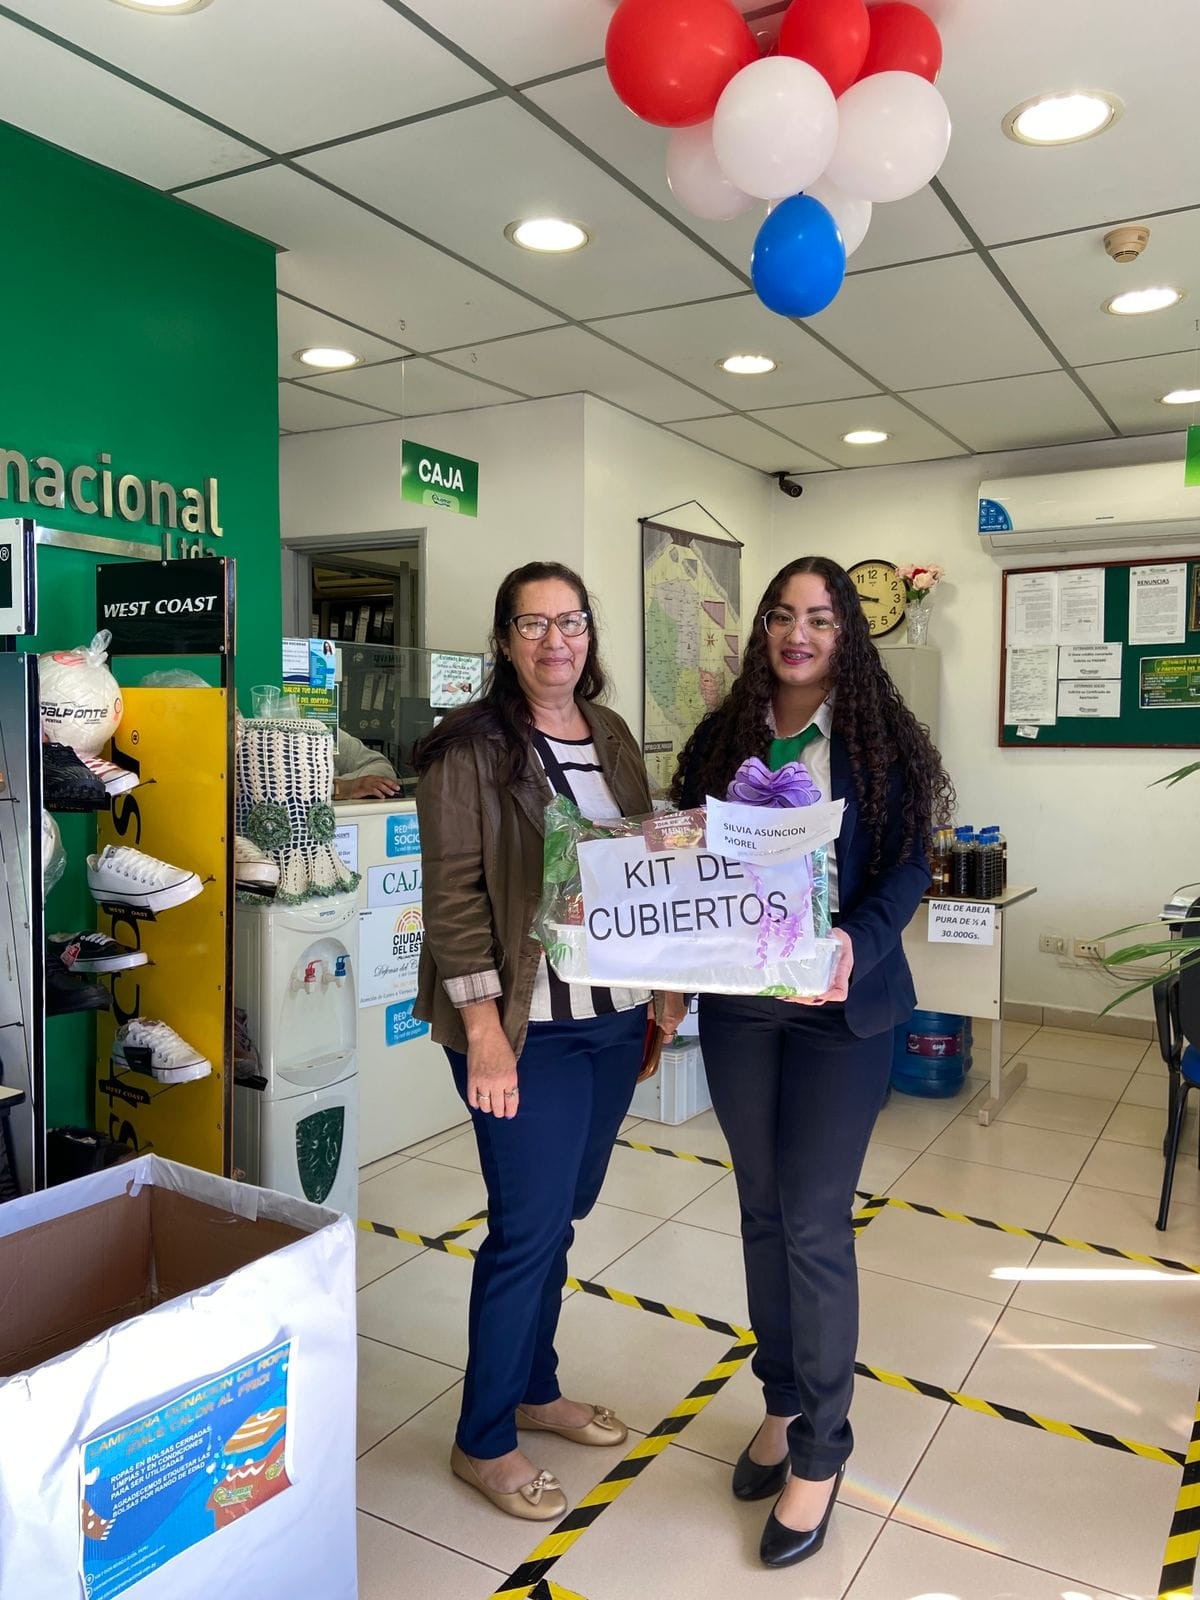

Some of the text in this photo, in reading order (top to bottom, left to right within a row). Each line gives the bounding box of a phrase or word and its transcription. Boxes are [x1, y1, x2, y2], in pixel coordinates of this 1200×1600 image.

[418, 458, 464, 492] CAJA
[857, 574, 865, 584] 11
[868, 569, 878, 580] 12
[884, 572, 888, 582] 1
[891, 581, 898, 591] 2
[1137, 578, 1170, 587] RENUNCIAS
[894, 593, 901, 604] 3
[104, 595, 217, 618] WEST COAST
[889, 606, 897, 616] 4
[881, 615, 889, 626] 5
[394, 824, 408, 834] RED
[723, 822, 806, 837] SILVIA ASUNCION
[724, 835, 757, 850] MOREL
[624, 854, 744, 889] KIT DE
[932, 903, 990, 914] MIEL DE ABEJA
[588, 890, 788, 941] CUBIERTOS
[935, 915, 957, 924] PURA
[959, 917, 970, 925] DE
[980, 919, 987, 927] A
[942, 930, 980, 940] 30.000Gs.
[392, 944, 407, 956] DEL
[393, 1011, 406, 1022] RED
[110, 1424, 212, 1485] ROPAS EN BOLSAS CERRADAS
[112, 1470, 140, 1491] LIMPIAS
[146, 1462, 157, 1472] EN
[157, 1437, 204, 1465] CONDICIONES
[110, 1454, 185, 1501] PARA SER UTILIZADAS
[112, 1451, 211, 1512] AGRADECEMOS ETIQUETAR LAS
[112, 1461, 206, 1518] BOLSAS POR RANGO DE EDAD
